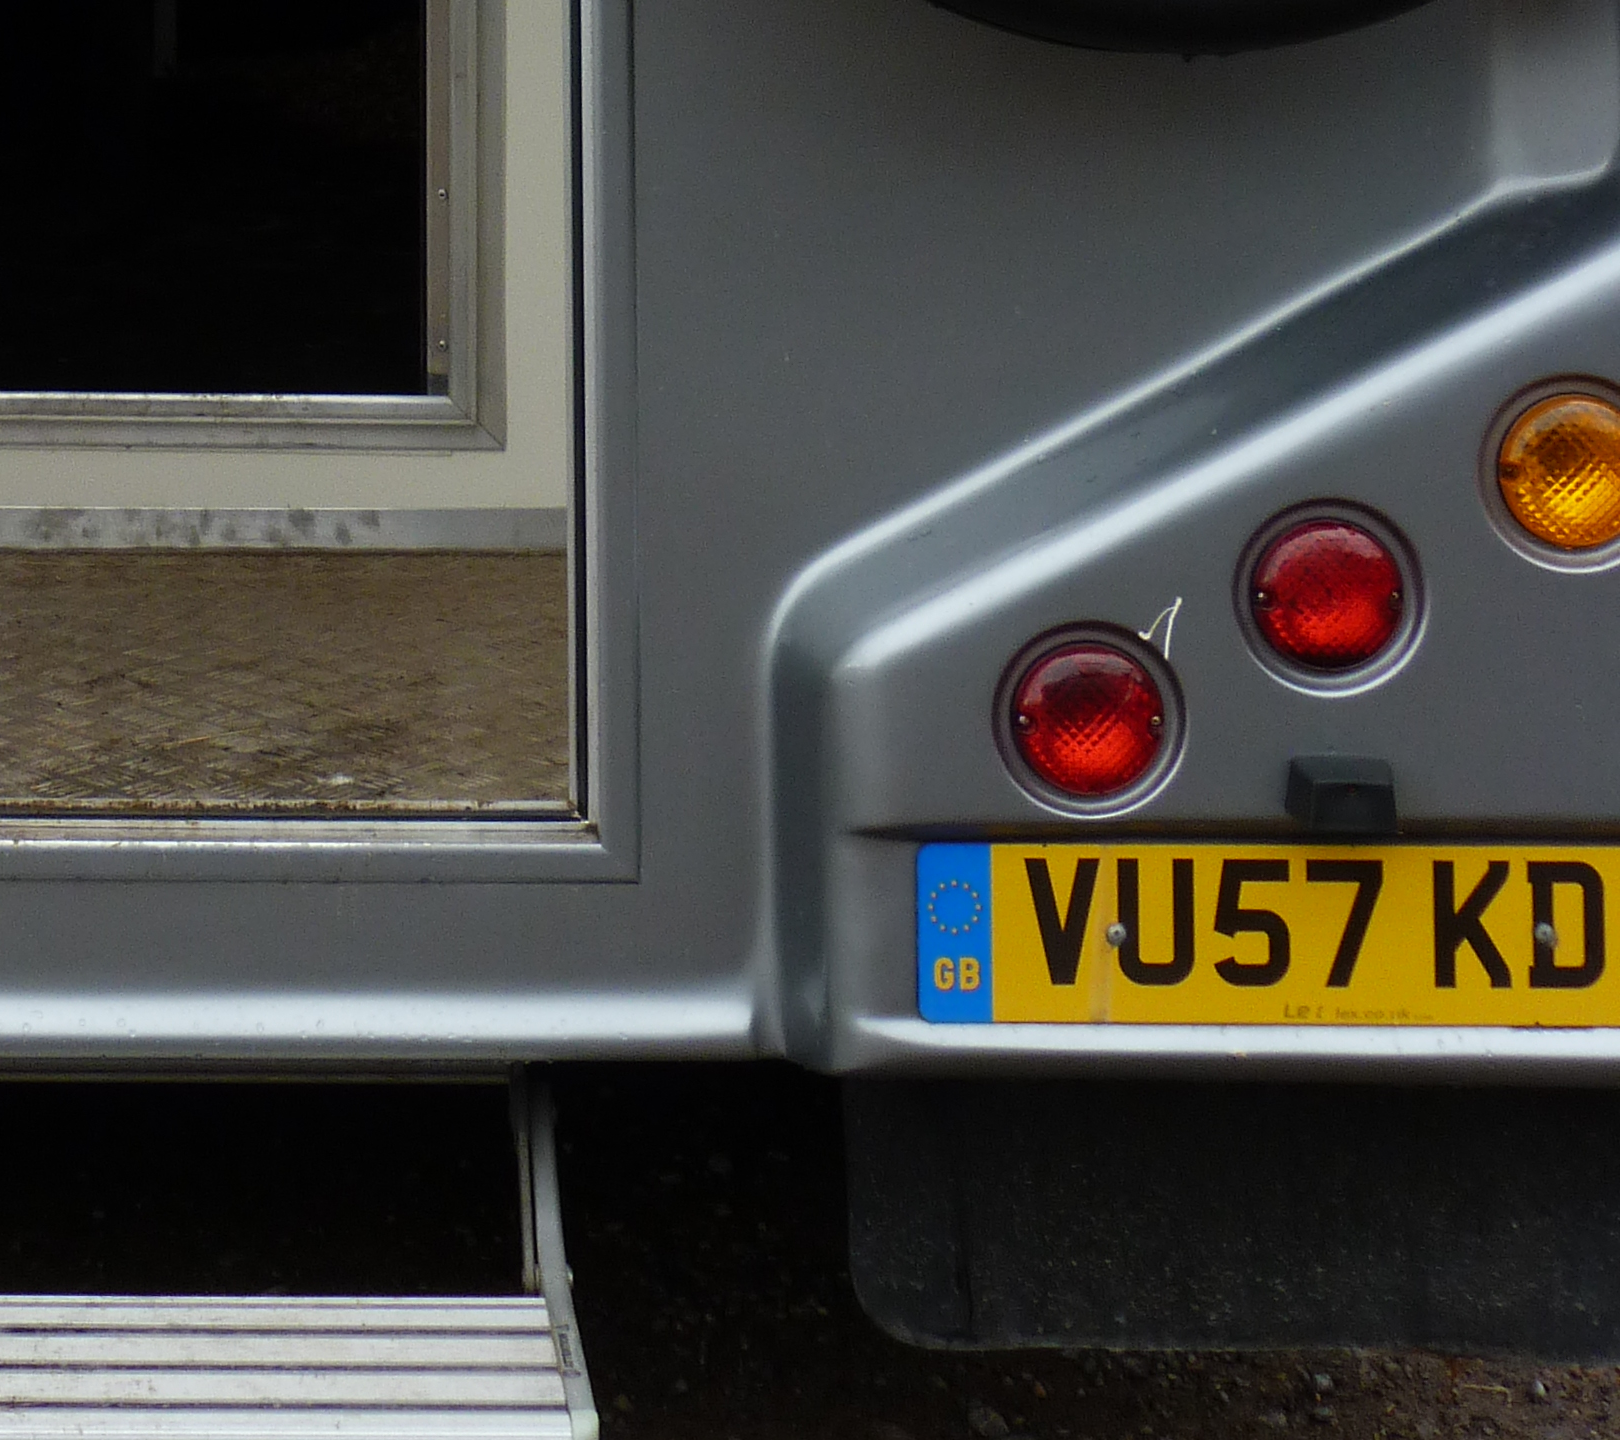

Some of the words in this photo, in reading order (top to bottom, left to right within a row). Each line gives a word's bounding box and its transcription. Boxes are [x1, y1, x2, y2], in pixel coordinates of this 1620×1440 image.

[1024, 858, 1383, 988] VU57
[1433, 860, 1606, 989] KD
[933, 957, 981, 991] GB
